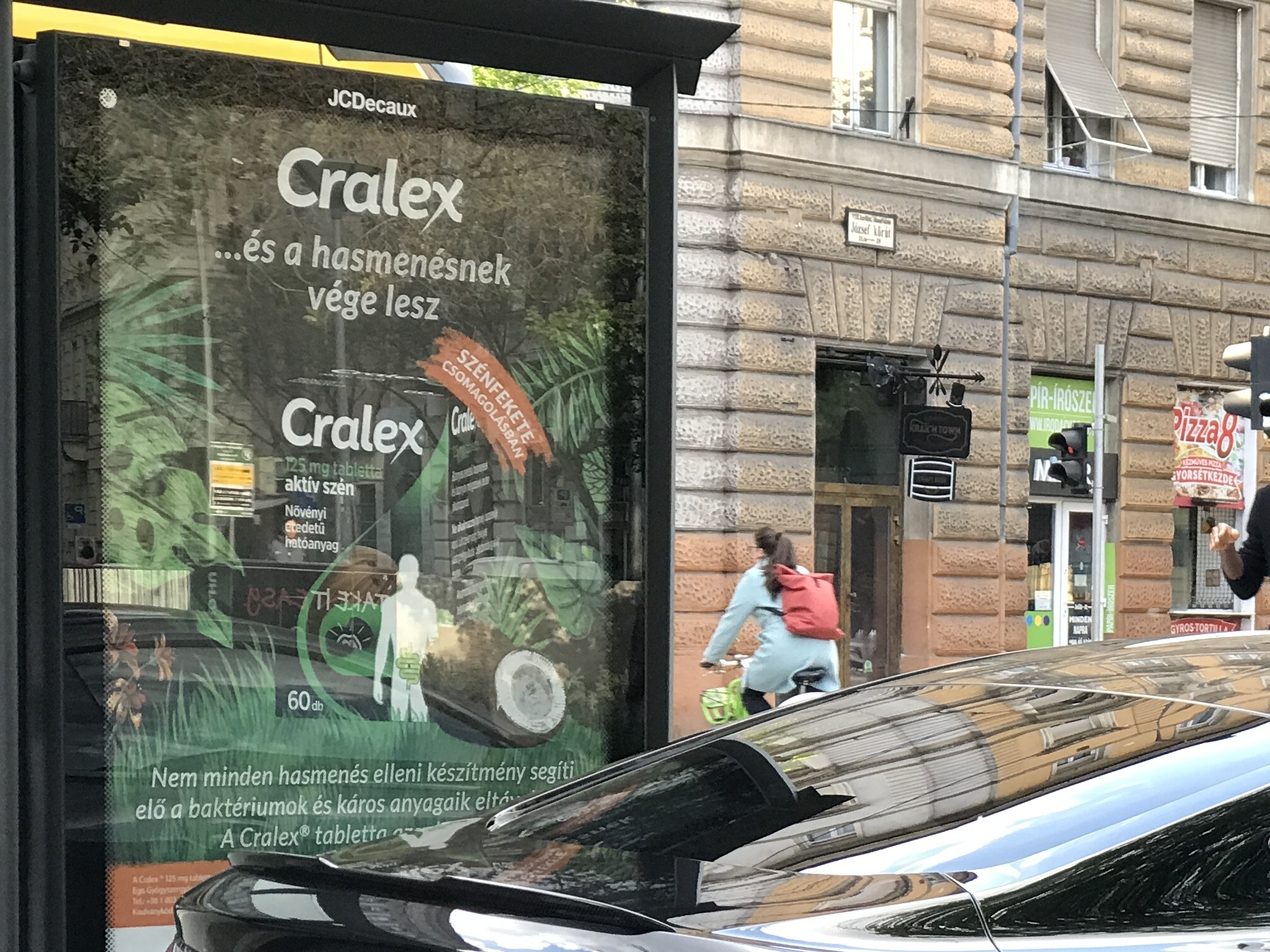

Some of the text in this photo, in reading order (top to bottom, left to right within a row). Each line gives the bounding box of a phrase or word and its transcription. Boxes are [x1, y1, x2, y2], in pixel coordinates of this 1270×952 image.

[327, 88, 418, 118] JCDecaux
[277, 147, 464, 235] Cralex
[284, 241, 303, 267] a
[311, 234, 512, 286] hasmenésnek
[307, 279, 441, 321] vége lesz
[442, 360, 524, 459] CSOMAGOLÁSBAN
[457, 349, 535, 444] SZÉNFEKETE
[1030, 381, 1095, 414] PÍR-ÍRÓSZE
[281, 397, 424, 465] Cralex
[451, 405, 476, 436] Crale
[309, 462, 330, 478] mg
[284, 475, 355, 497] aktív szén
[284, 536, 339, 554] hatóanyag
[287, 690, 324, 711] 60 db
[152, 760, 575, 788] Nem minden hasmenés elleni készítmény segíti
[135, 797, 166, 820] elő
[170, 805, 183, 819] a
[188, 794, 309, 819] baktériumok
[312, 794, 332, 815] és
[337, 793, 386, 815] káros
[390, 791, 470, 816] anyagaik
[219, 828, 235, 849] A
[316, 824, 387, 845] tabletta
